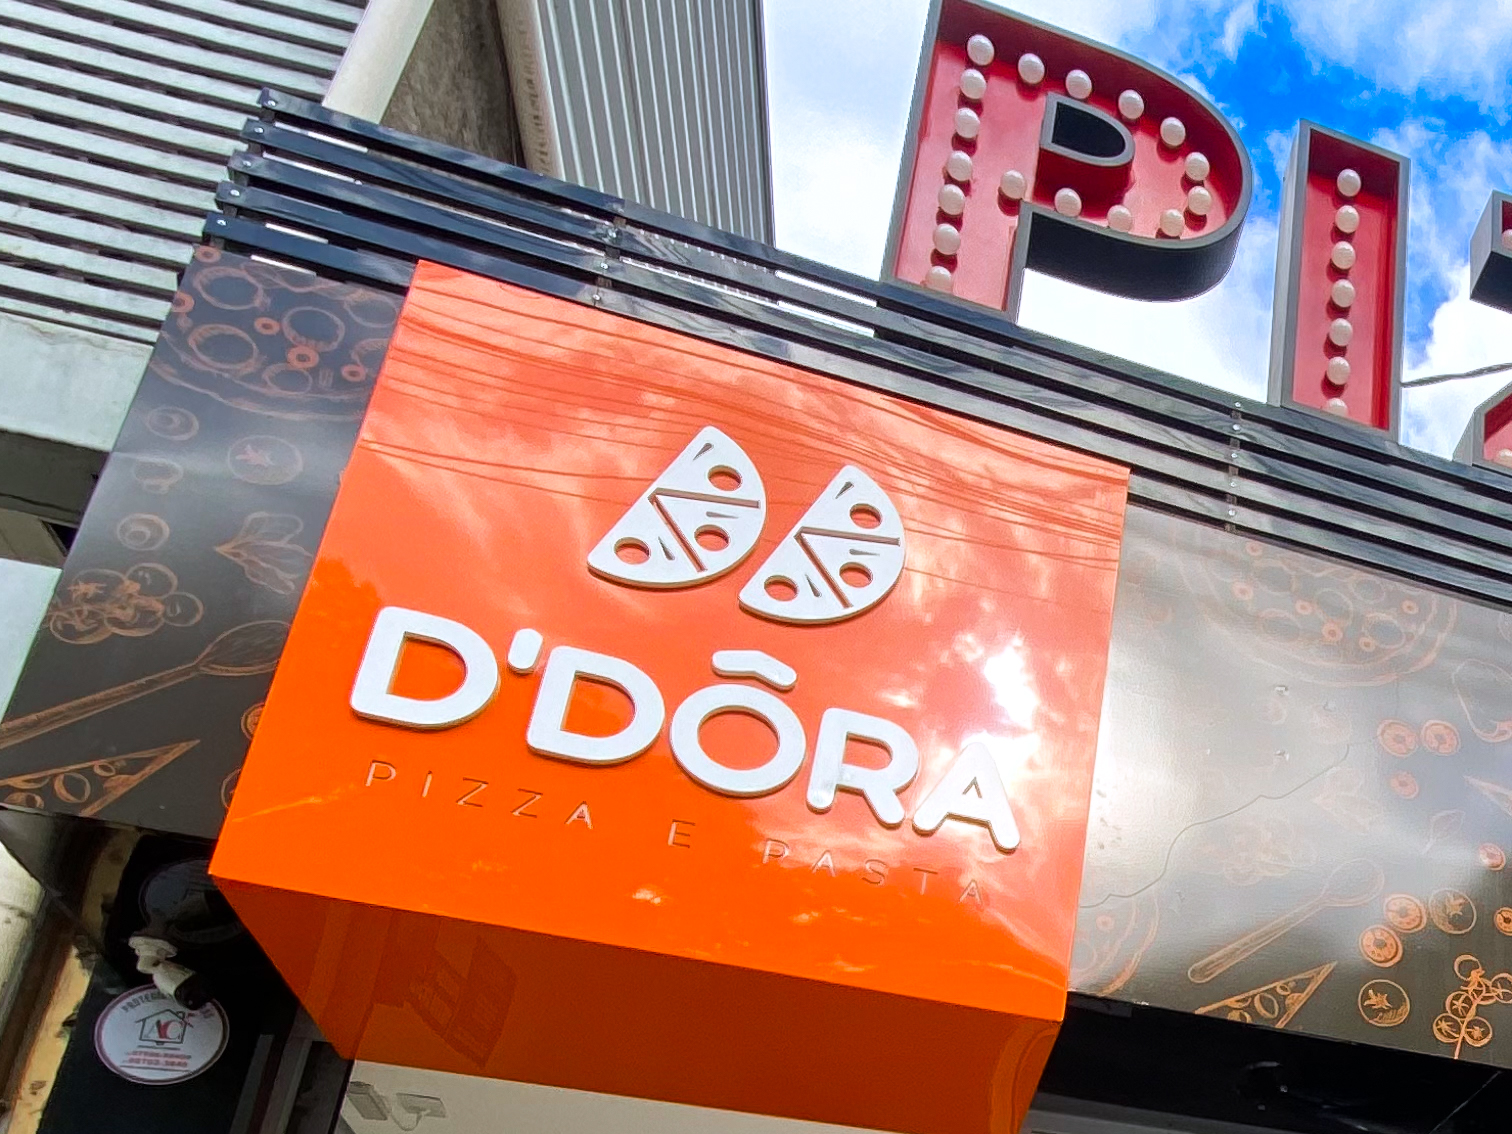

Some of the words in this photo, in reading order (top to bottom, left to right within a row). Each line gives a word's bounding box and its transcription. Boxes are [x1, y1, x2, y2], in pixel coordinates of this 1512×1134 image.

[350, 605, 1021, 852] D'DÔRA
[365, 759, 594, 829] PIZZA
[667, 818, 696, 849] E
[761, 836, 984, 905] PASTA
